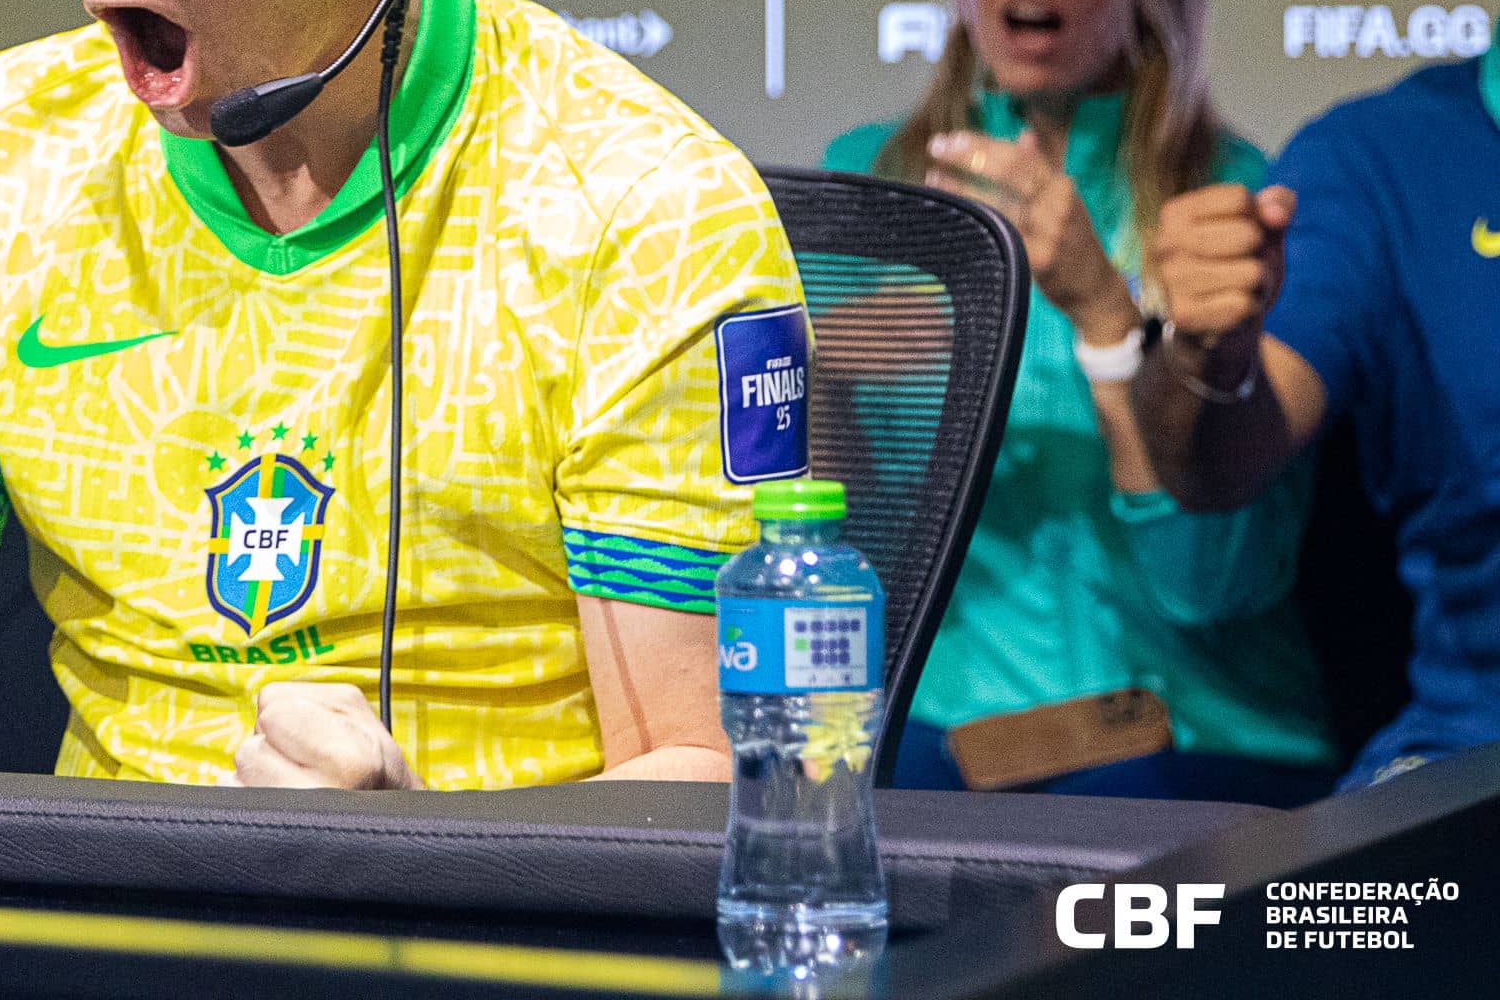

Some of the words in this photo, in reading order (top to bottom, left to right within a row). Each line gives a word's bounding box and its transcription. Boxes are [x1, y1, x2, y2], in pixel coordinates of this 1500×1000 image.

[741, 366, 804, 409] FINALS
[776, 404, 791, 431] 25
[243, 529, 289, 549] CBF
[188, 623, 335, 665] BRASIL
